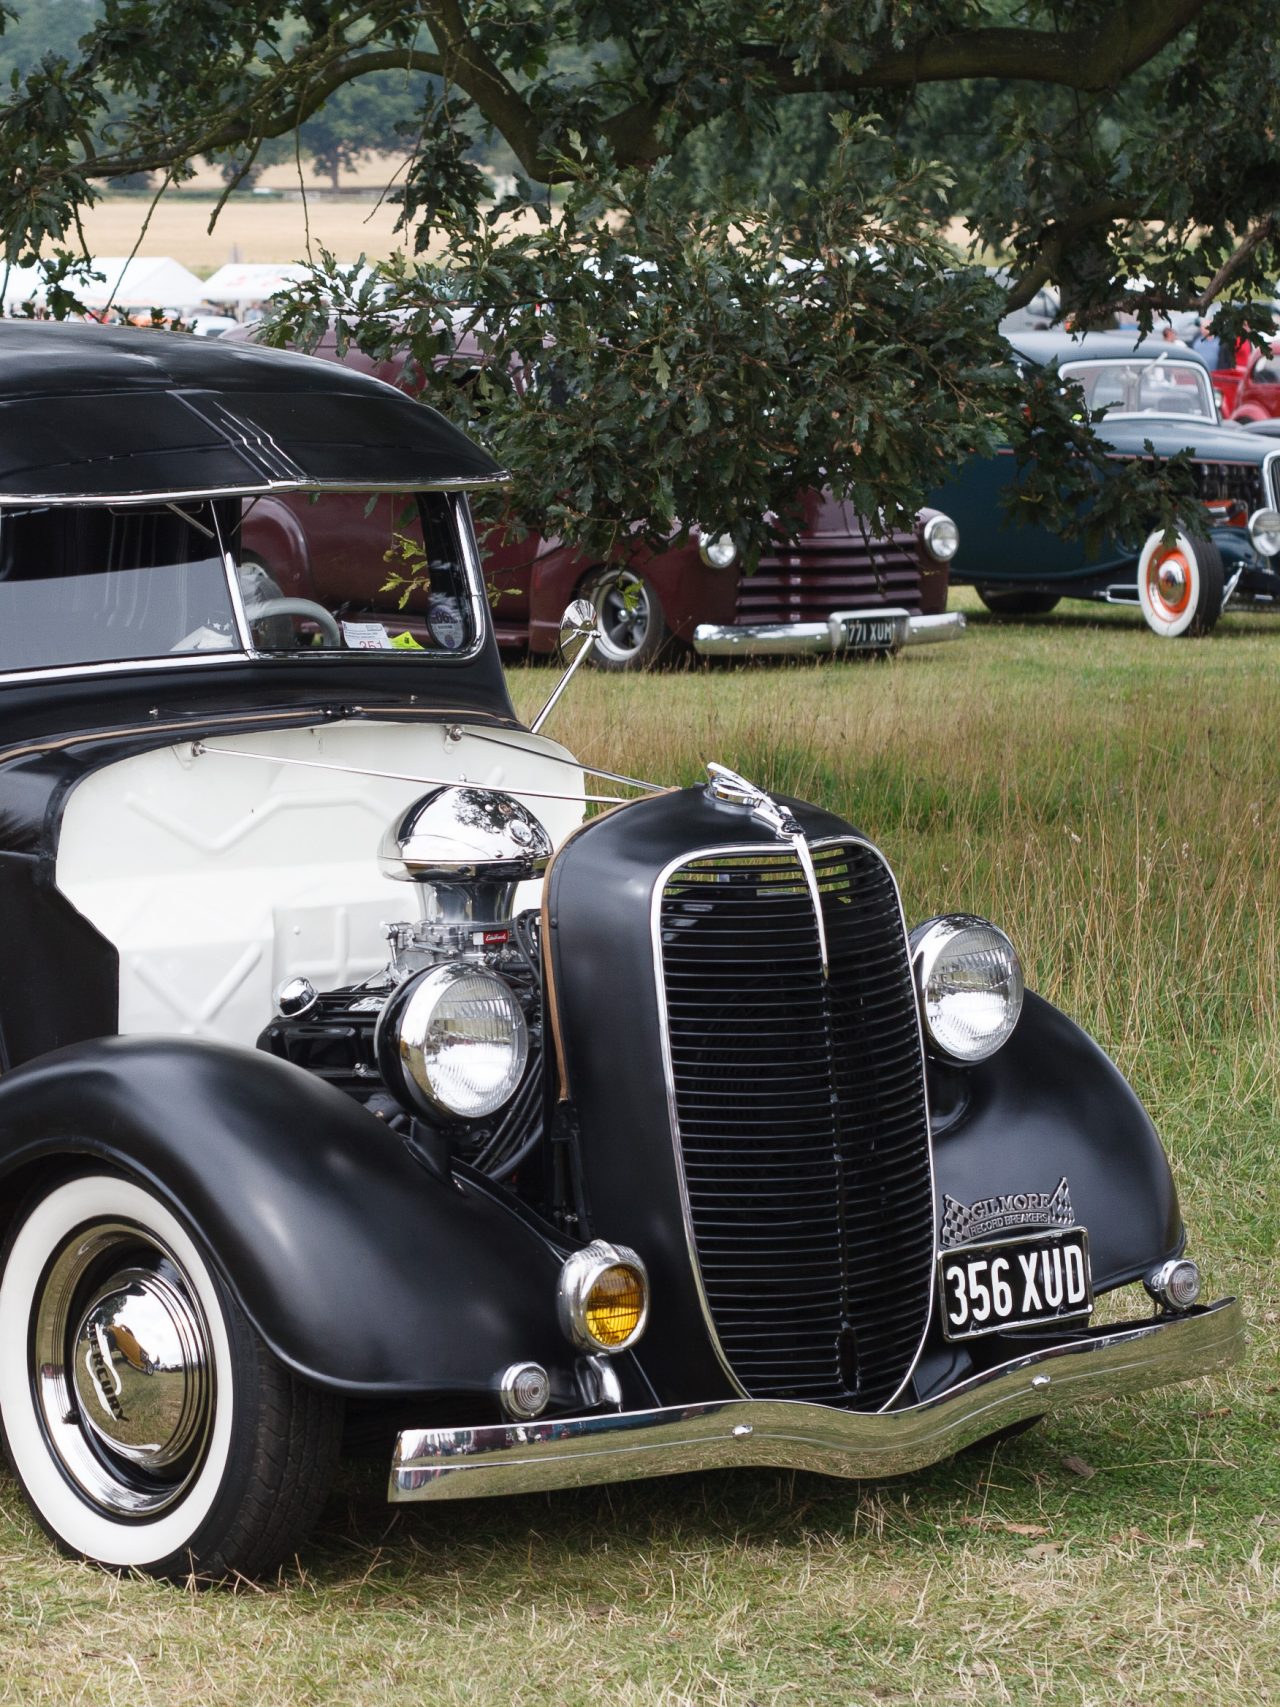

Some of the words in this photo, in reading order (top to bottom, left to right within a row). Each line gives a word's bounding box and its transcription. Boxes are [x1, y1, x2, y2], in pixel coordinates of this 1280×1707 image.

[849, 622, 867, 642] 771
[870, 622, 892, 641] XUM
[971, 1193, 1050, 1219] GILMORE
[970, 1217, 1004, 1237] RECORD
[1004, 1212, 1048, 1225] BREAKERS
[946, 1258, 1013, 1325] 356
[1017, 1245, 1086, 1313] XUD
